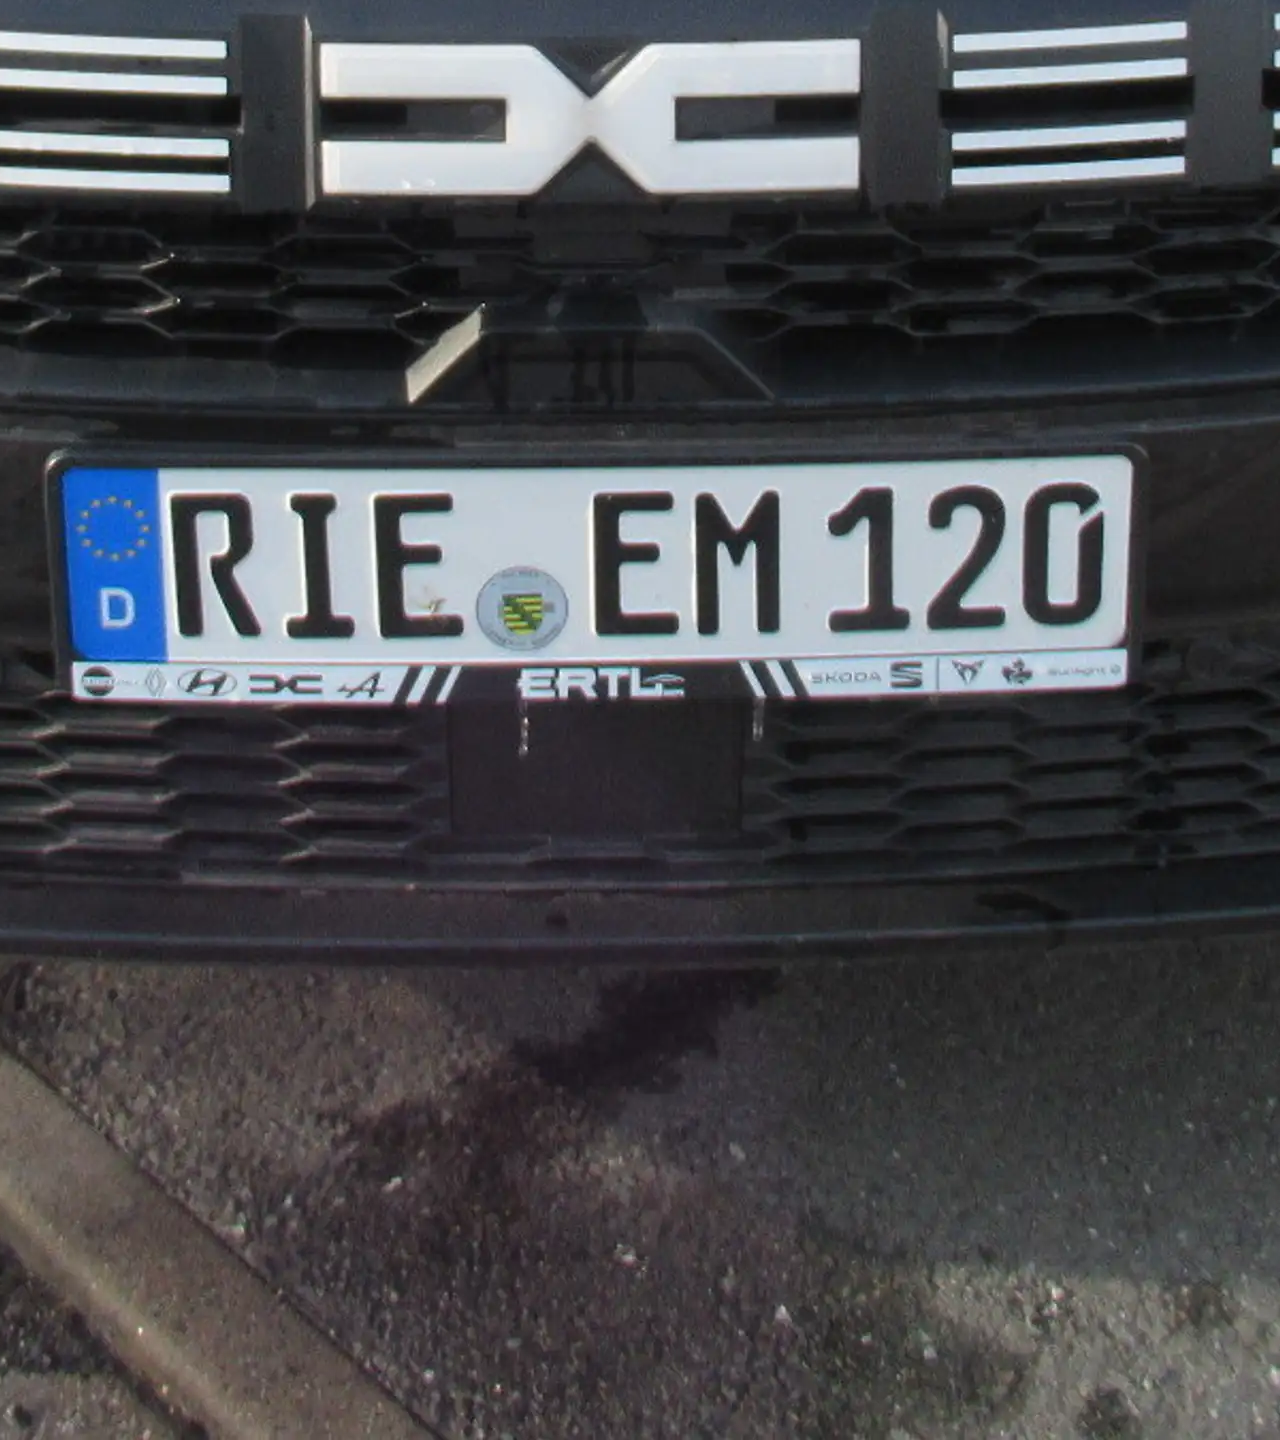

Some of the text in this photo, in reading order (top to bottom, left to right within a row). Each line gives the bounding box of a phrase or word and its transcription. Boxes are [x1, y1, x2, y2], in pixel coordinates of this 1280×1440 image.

[170, 482, 1104, 639] RIE EM 120
[100, 587, 136, 629] D
[519, 666, 666, 699] ERTL
